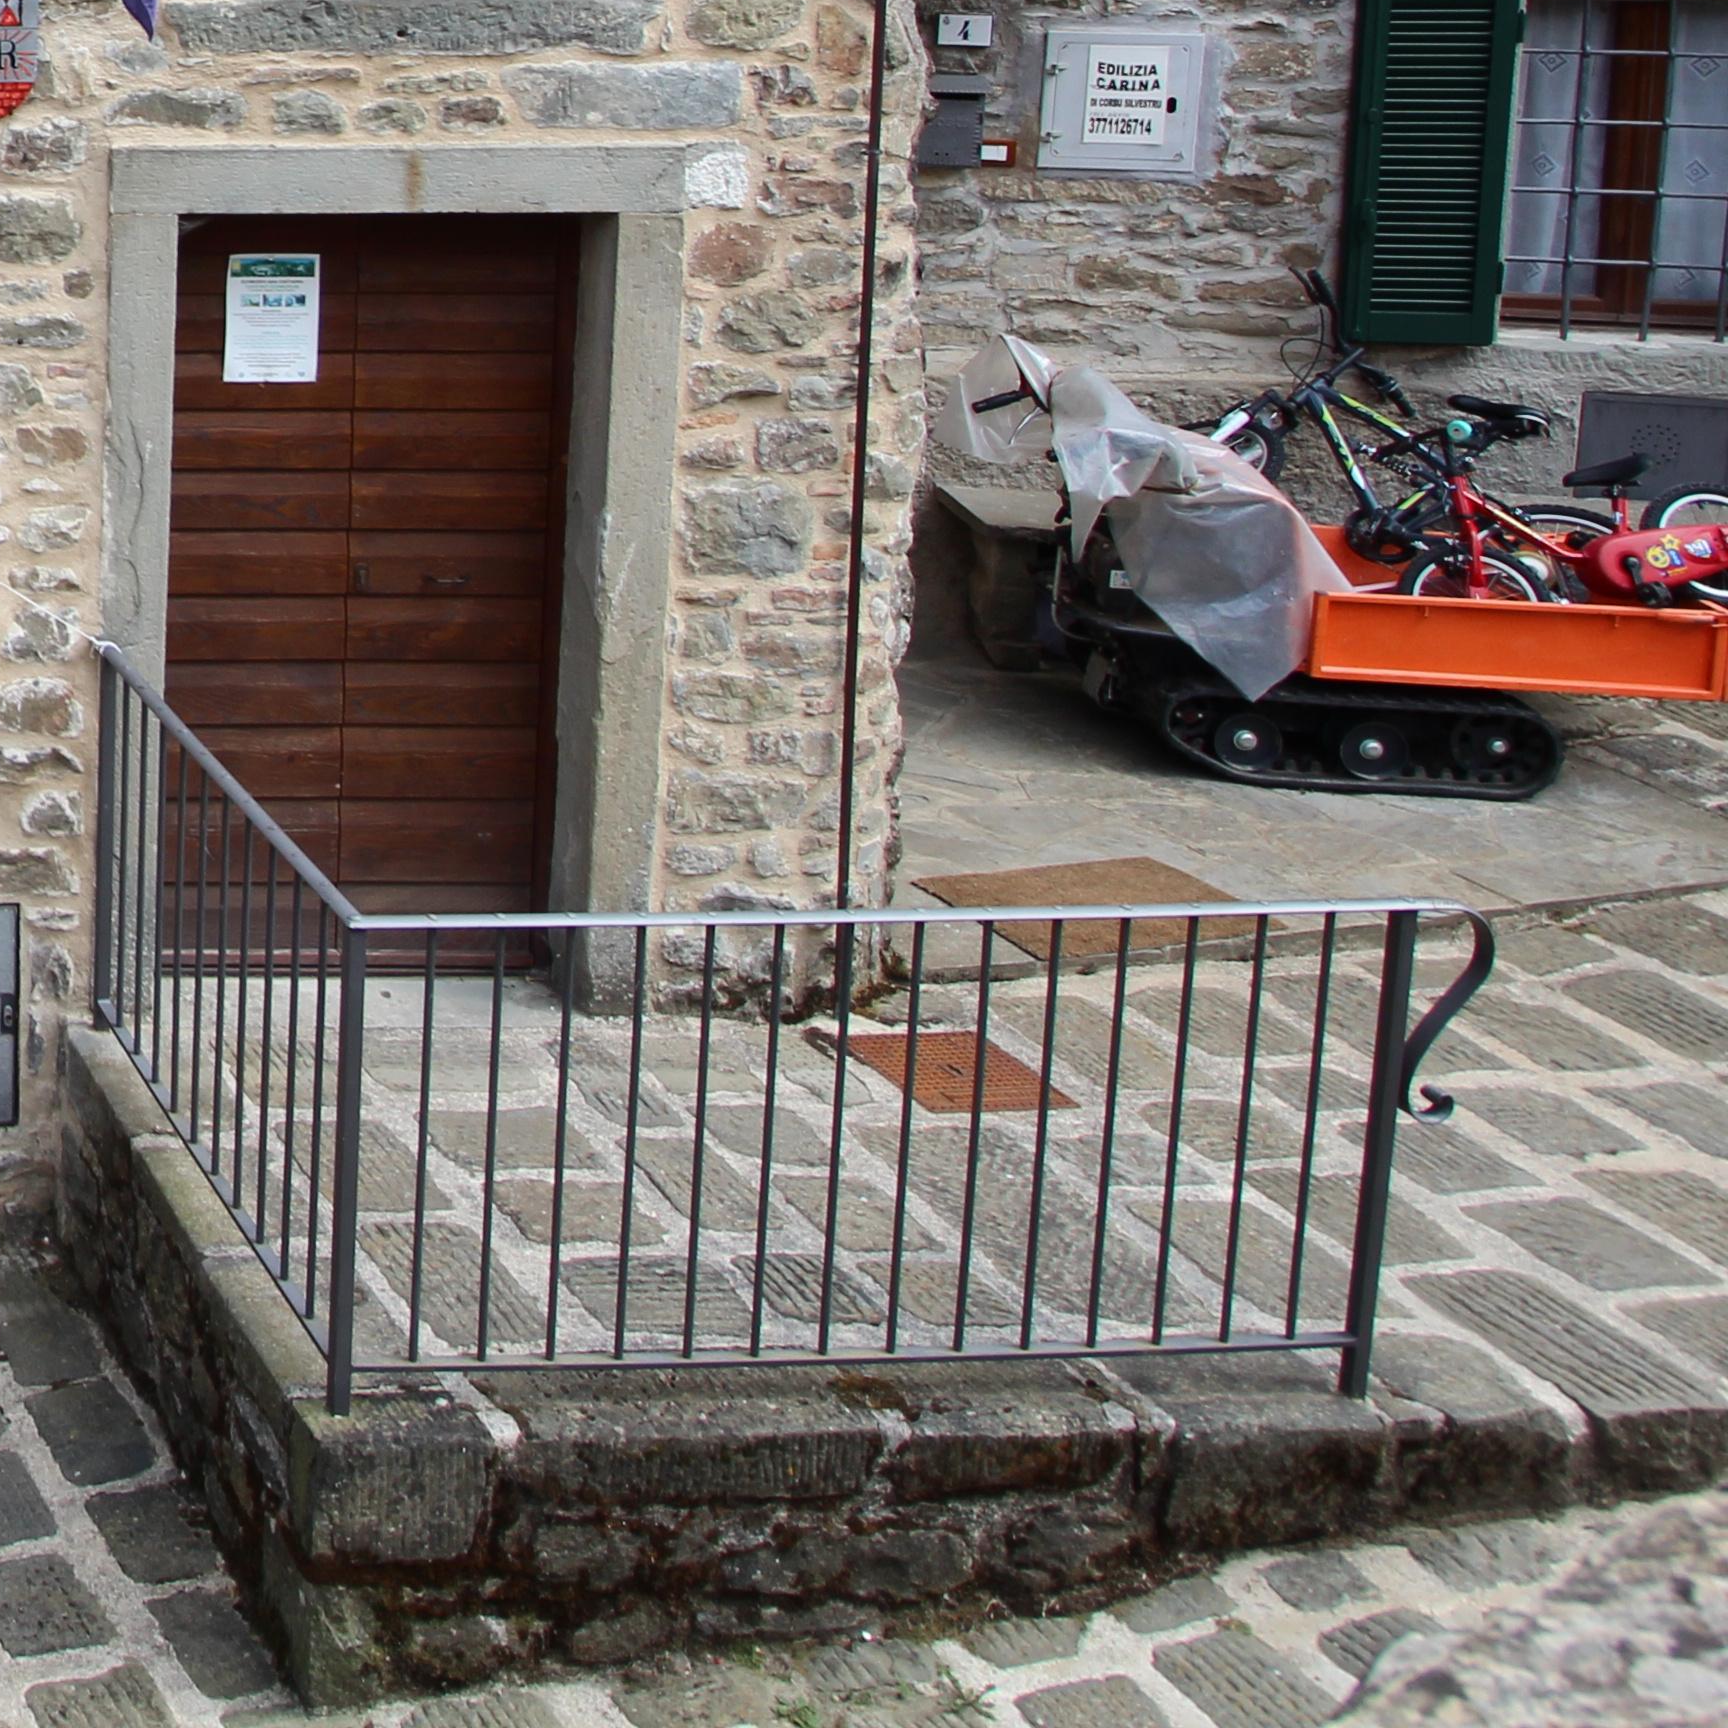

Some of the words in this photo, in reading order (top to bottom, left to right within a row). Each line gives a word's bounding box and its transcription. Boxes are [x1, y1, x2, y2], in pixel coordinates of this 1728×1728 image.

[957, 20, 971, 41] 4
[1097, 61, 1158, 77] EDILIZIA
[1096, 77, 1161, 92] CARINA
[1090, 98, 1097, 107] DI
[1124, 99, 1162, 109] SILVESTRU
[1088, 117, 1152, 135] 3771126714
